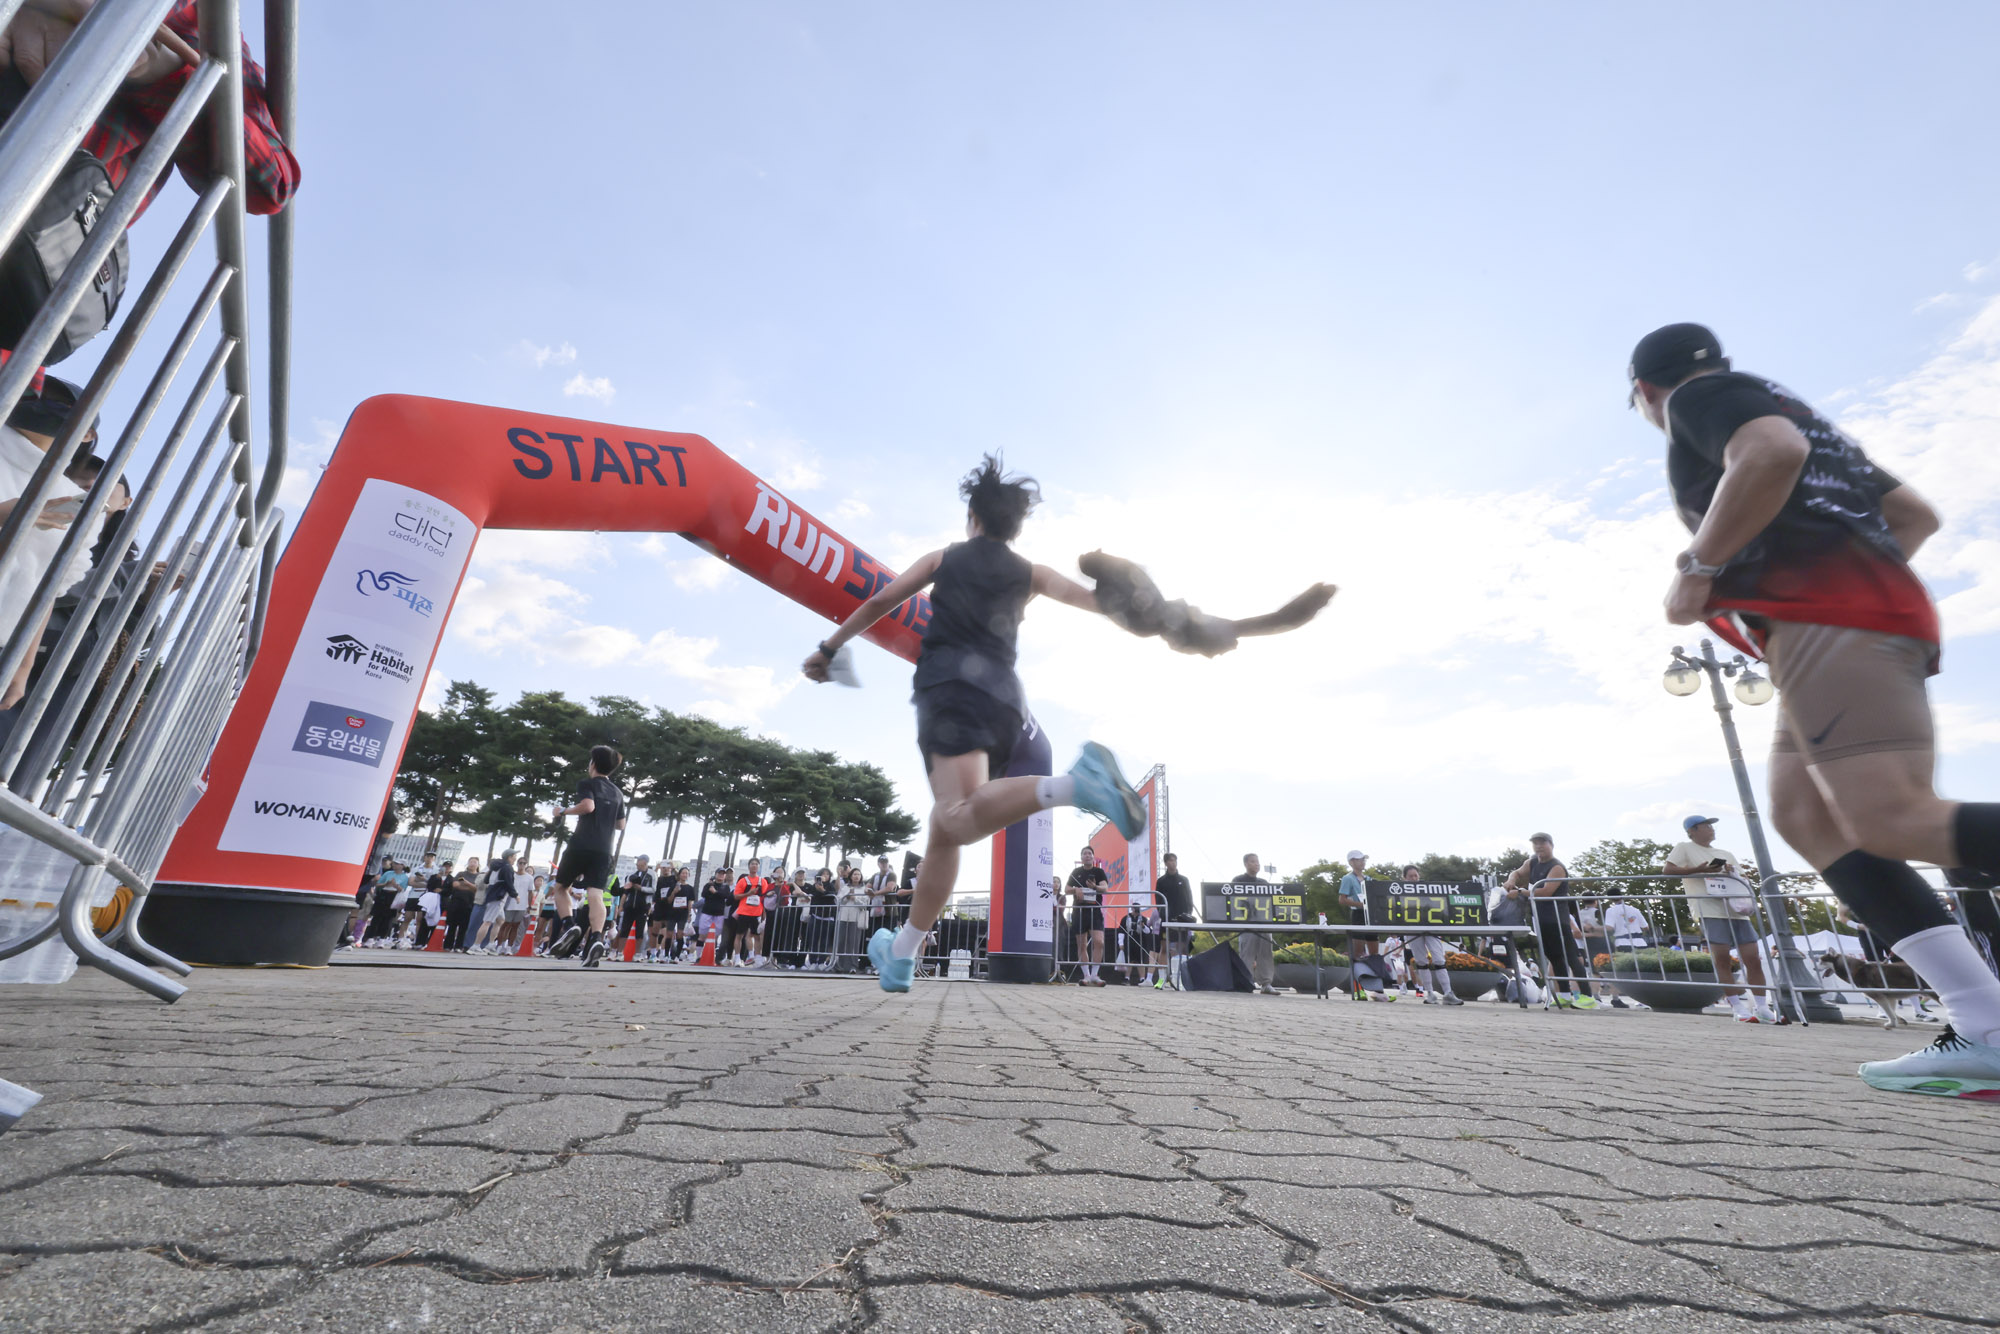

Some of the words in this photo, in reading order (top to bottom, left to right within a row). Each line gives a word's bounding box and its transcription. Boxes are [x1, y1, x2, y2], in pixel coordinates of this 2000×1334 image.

[507, 427, 687, 487] START
[395, 512, 452, 549] 대디
[388, 530, 422, 547] daddy
[423, 542, 445, 558] food
[365, 670, 382, 679] Korea
[368, 661, 380, 671] for
[381, 666, 410, 684] Humanity
[370, 650, 414, 676] Habitat
[305, 726, 381, 759] 동원샘물
[254, 800, 331, 822] WOMAN
[333, 811, 371, 830] SENSE
[1234, 884, 1284, 895] SAMIK
[1278, 896, 1296, 904] 5km
[1403, 883, 1460, 895] SAMIK
[1453, 895, 1478, 904] 10km
